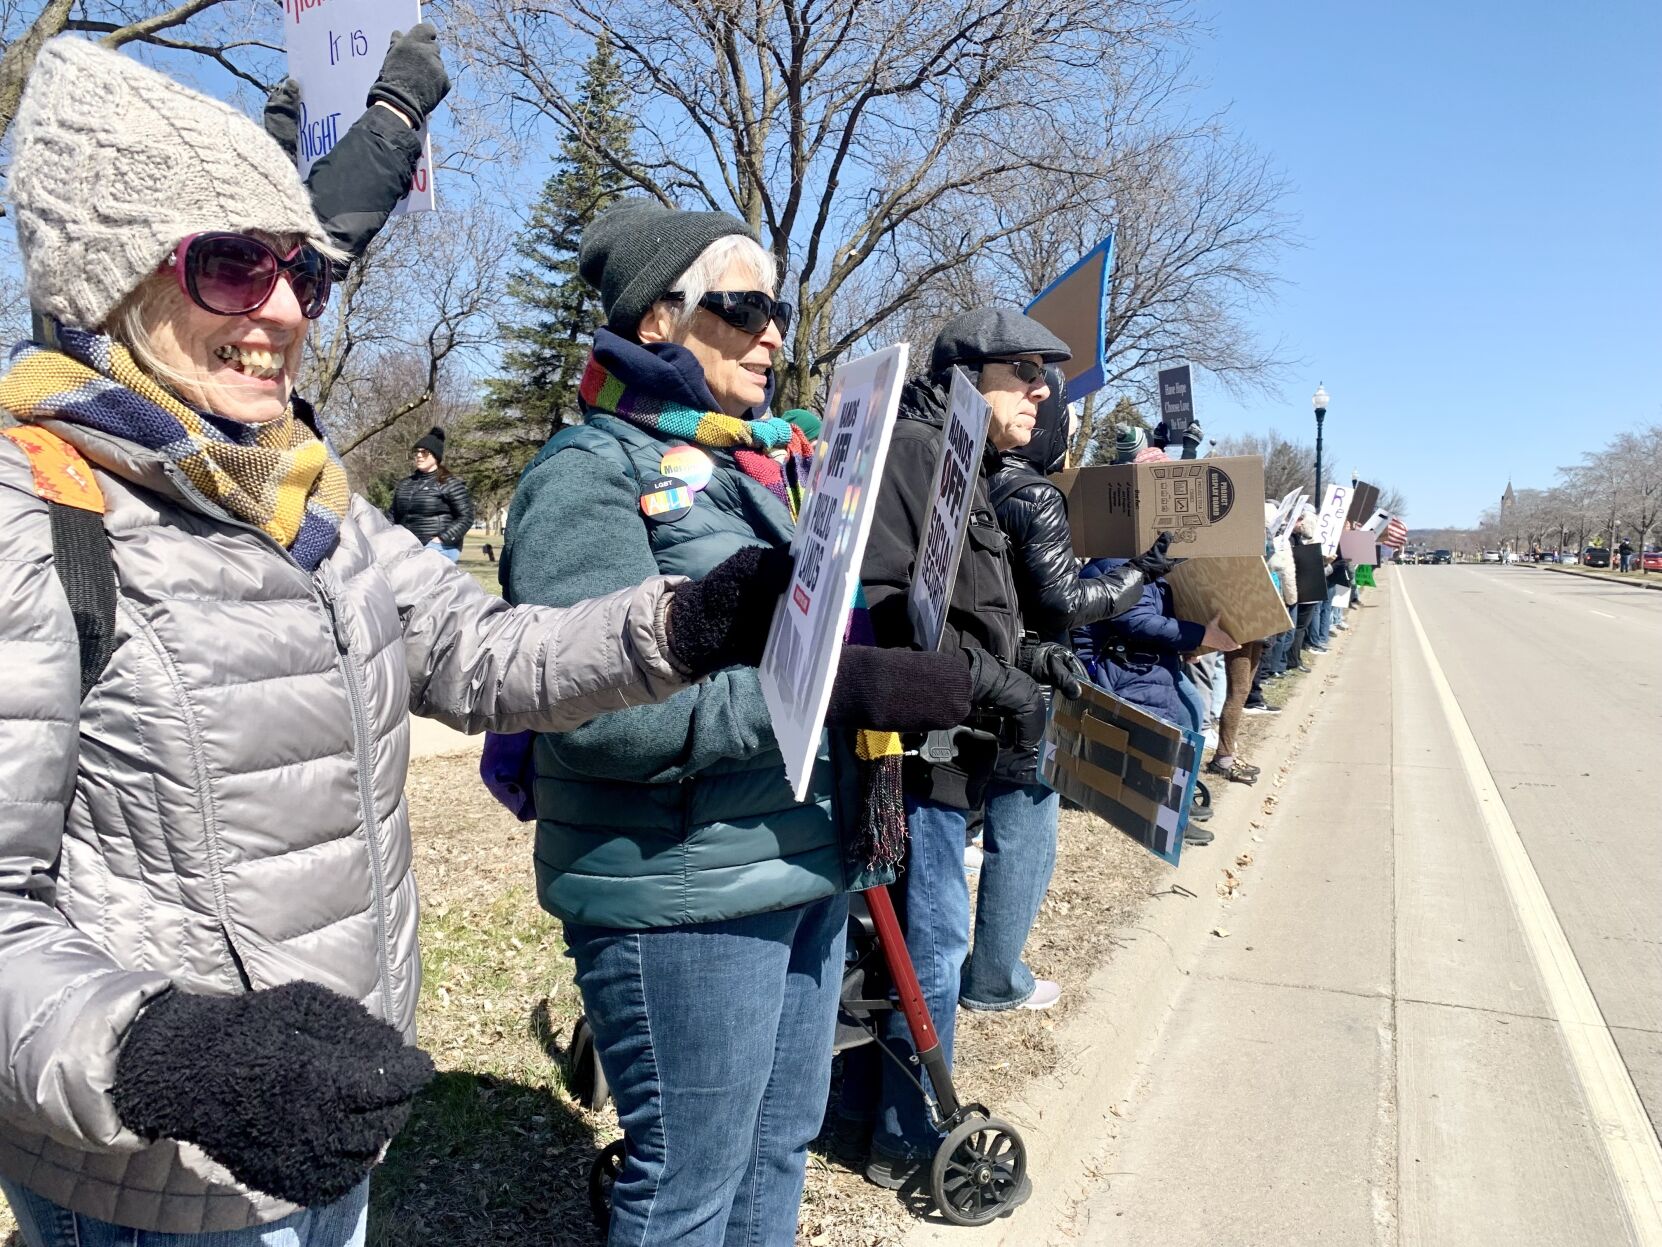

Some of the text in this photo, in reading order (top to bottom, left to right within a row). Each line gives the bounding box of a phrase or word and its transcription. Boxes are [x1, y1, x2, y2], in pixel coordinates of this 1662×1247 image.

[350, 30, 368, 57] IS
[299, 101, 341, 162] RIGHT
[948, 412, 974, 473] HANDS
[1211, 473, 1220, 516] DISPLAY BOARD
[1220, 481, 1228, 506] PROJECT
[928, 505, 953, 582] SOCIAL
